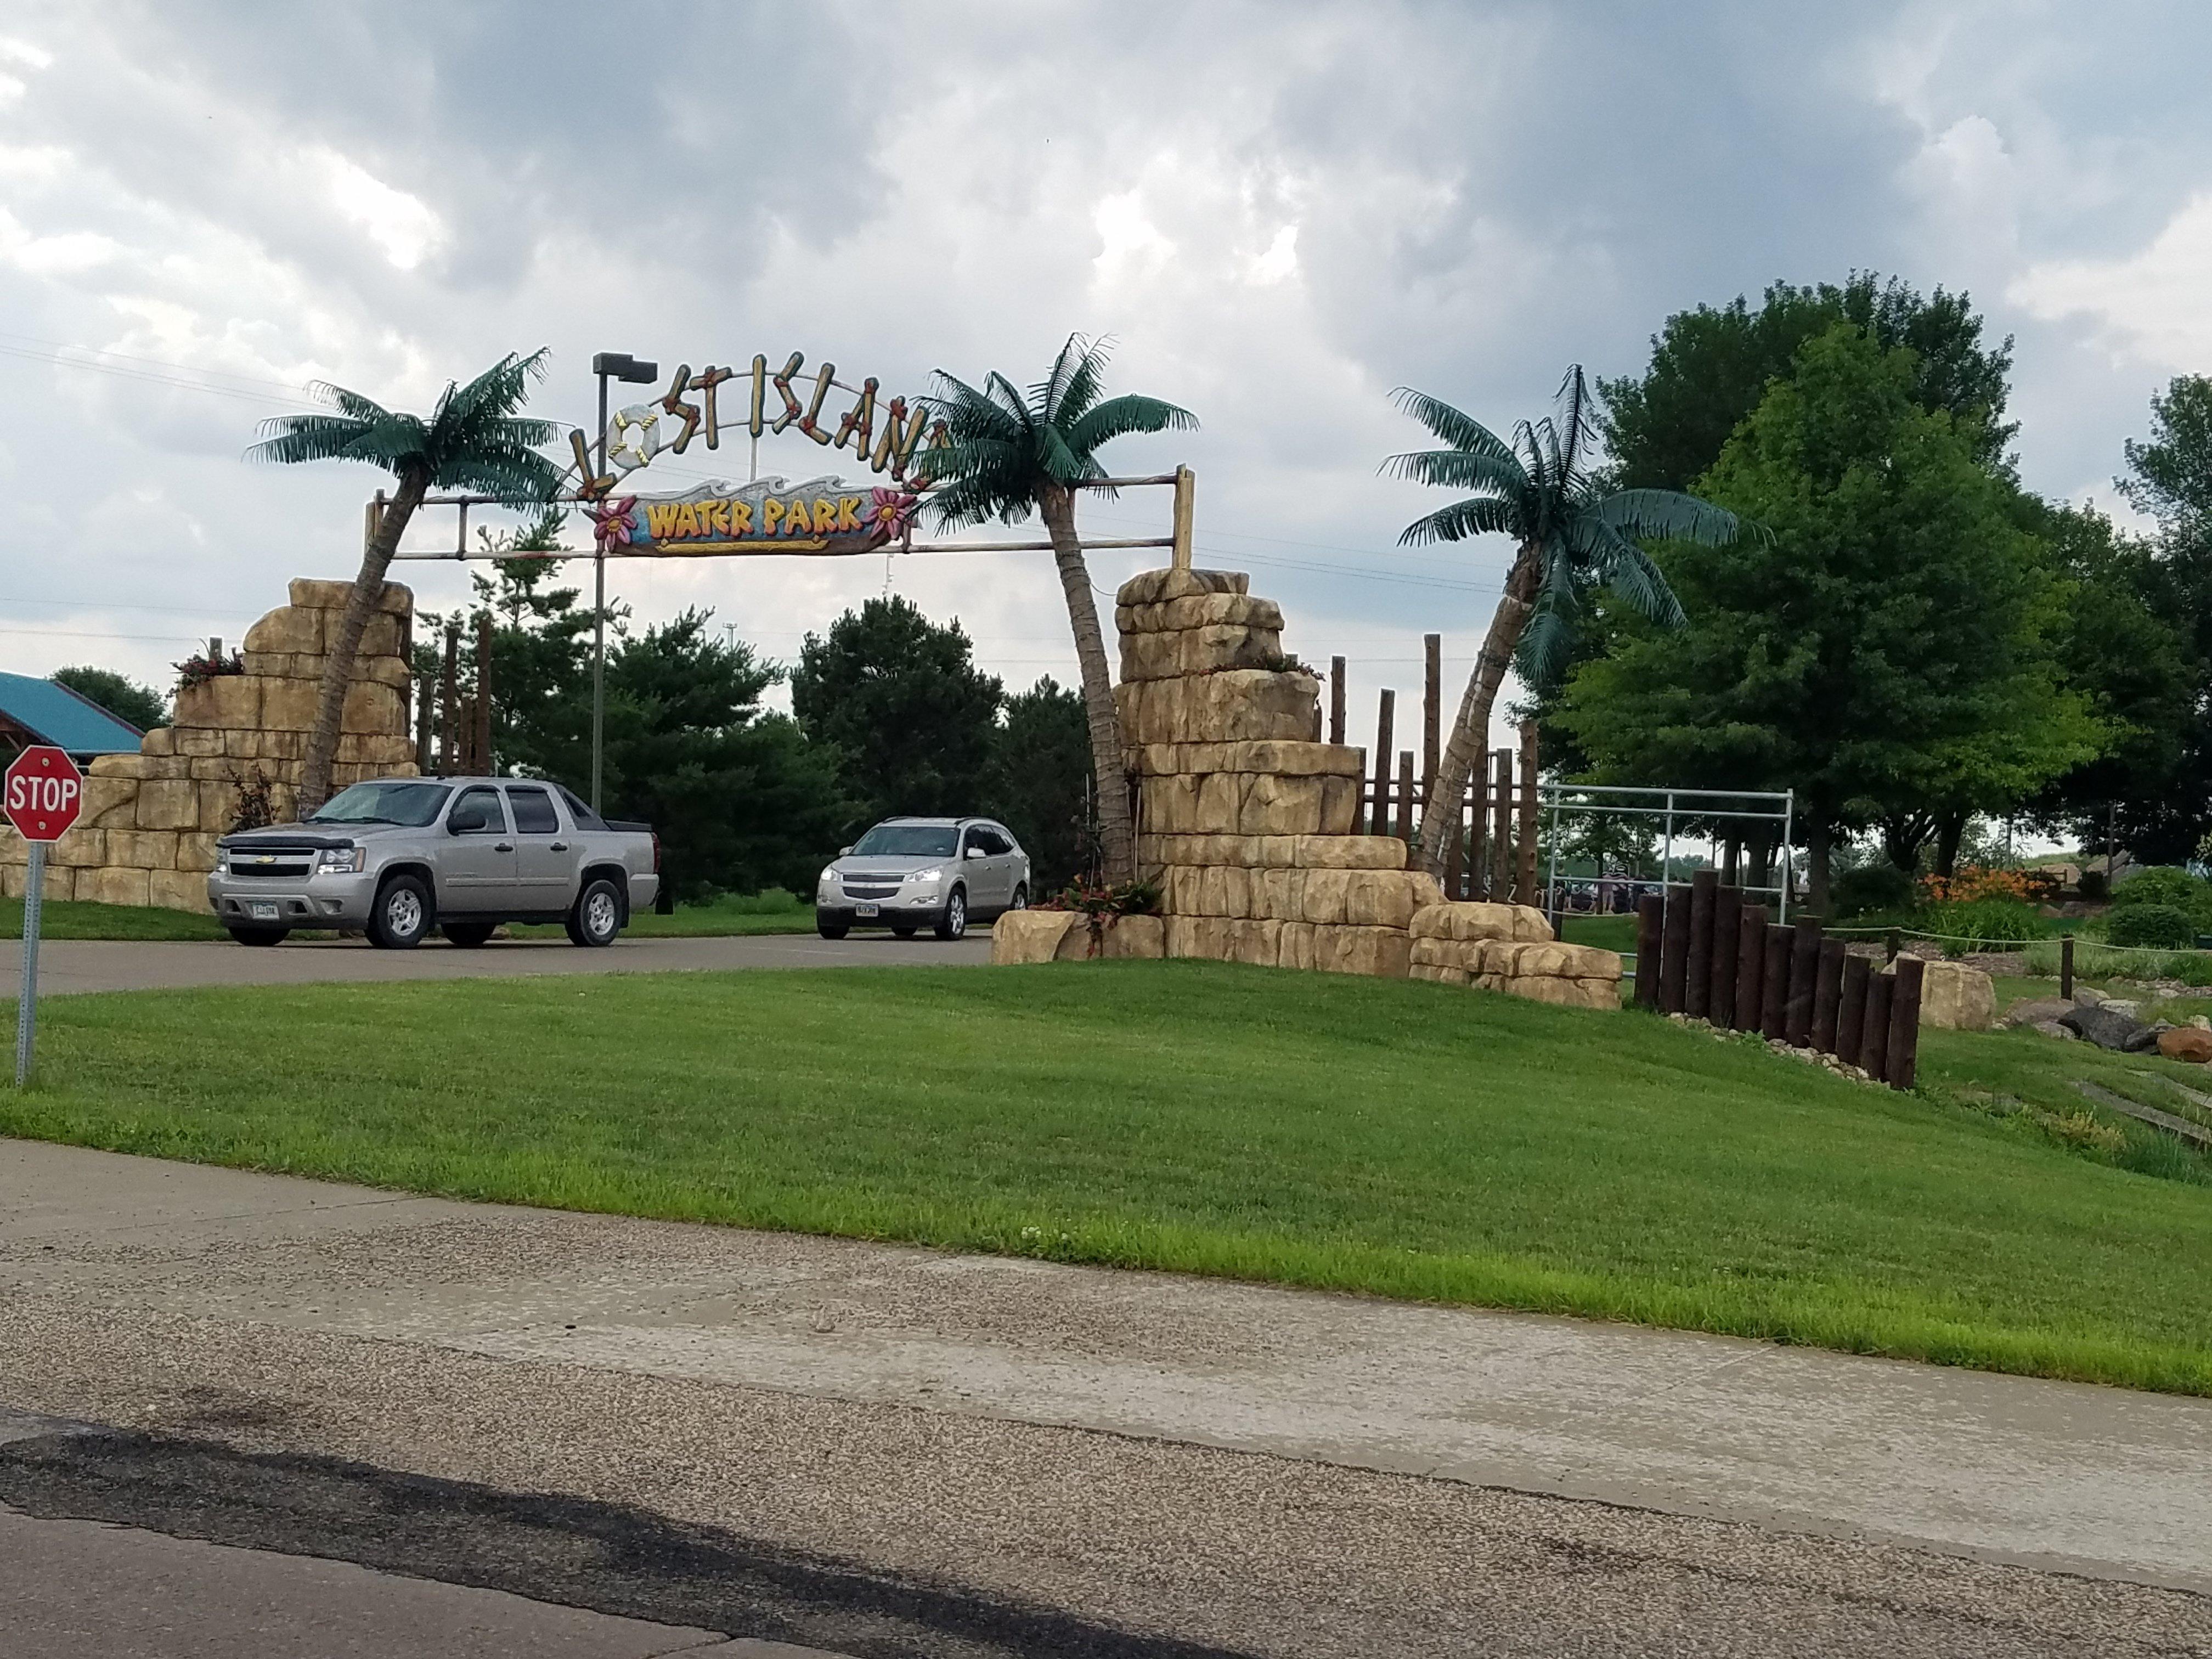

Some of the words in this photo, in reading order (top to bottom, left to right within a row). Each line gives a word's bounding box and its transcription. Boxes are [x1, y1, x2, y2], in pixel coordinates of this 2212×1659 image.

[569, 364, 732, 500] LOST
[647, 499, 754, 539] WATER
[764, 497, 864, 535] PARK
[10, 775, 77, 811] STOP
